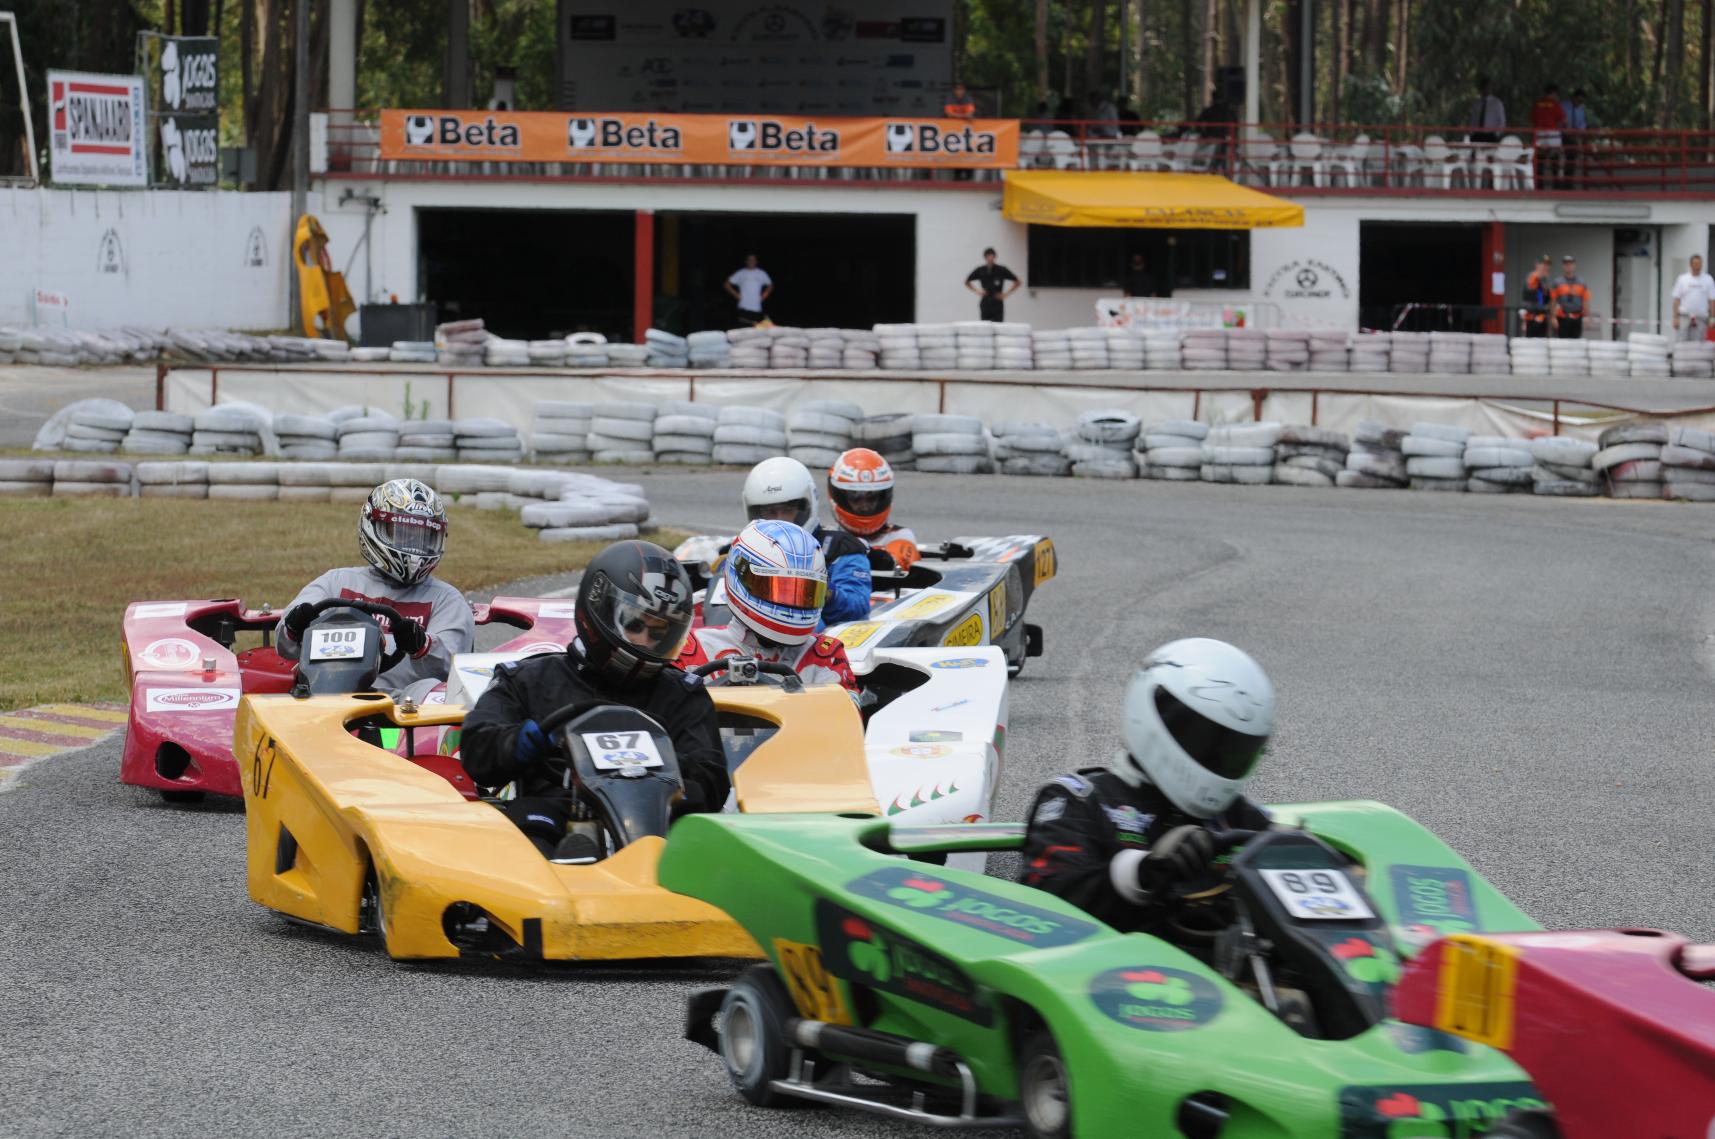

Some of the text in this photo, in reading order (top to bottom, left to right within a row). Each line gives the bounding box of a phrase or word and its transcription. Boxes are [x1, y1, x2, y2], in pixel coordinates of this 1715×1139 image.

[69, 97, 131, 141] SPANJAARD
[439, 117, 519, 147] Beta
[601, 119, 680, 148] Beta
[760, 121, 839, 151] Beta
[919, 124, 996, 153] Beta
[391, 515, 442, 531] clube bcp
[321, 631, 357, 643] 100
[164, 693, 221, 702] Millennium
[595, 733, 640, 751] 67
[253, 732, 277, 800] 67
[1280, 872, 1339, 894] 89
[936, 898, 1063, 935] JOGOS
